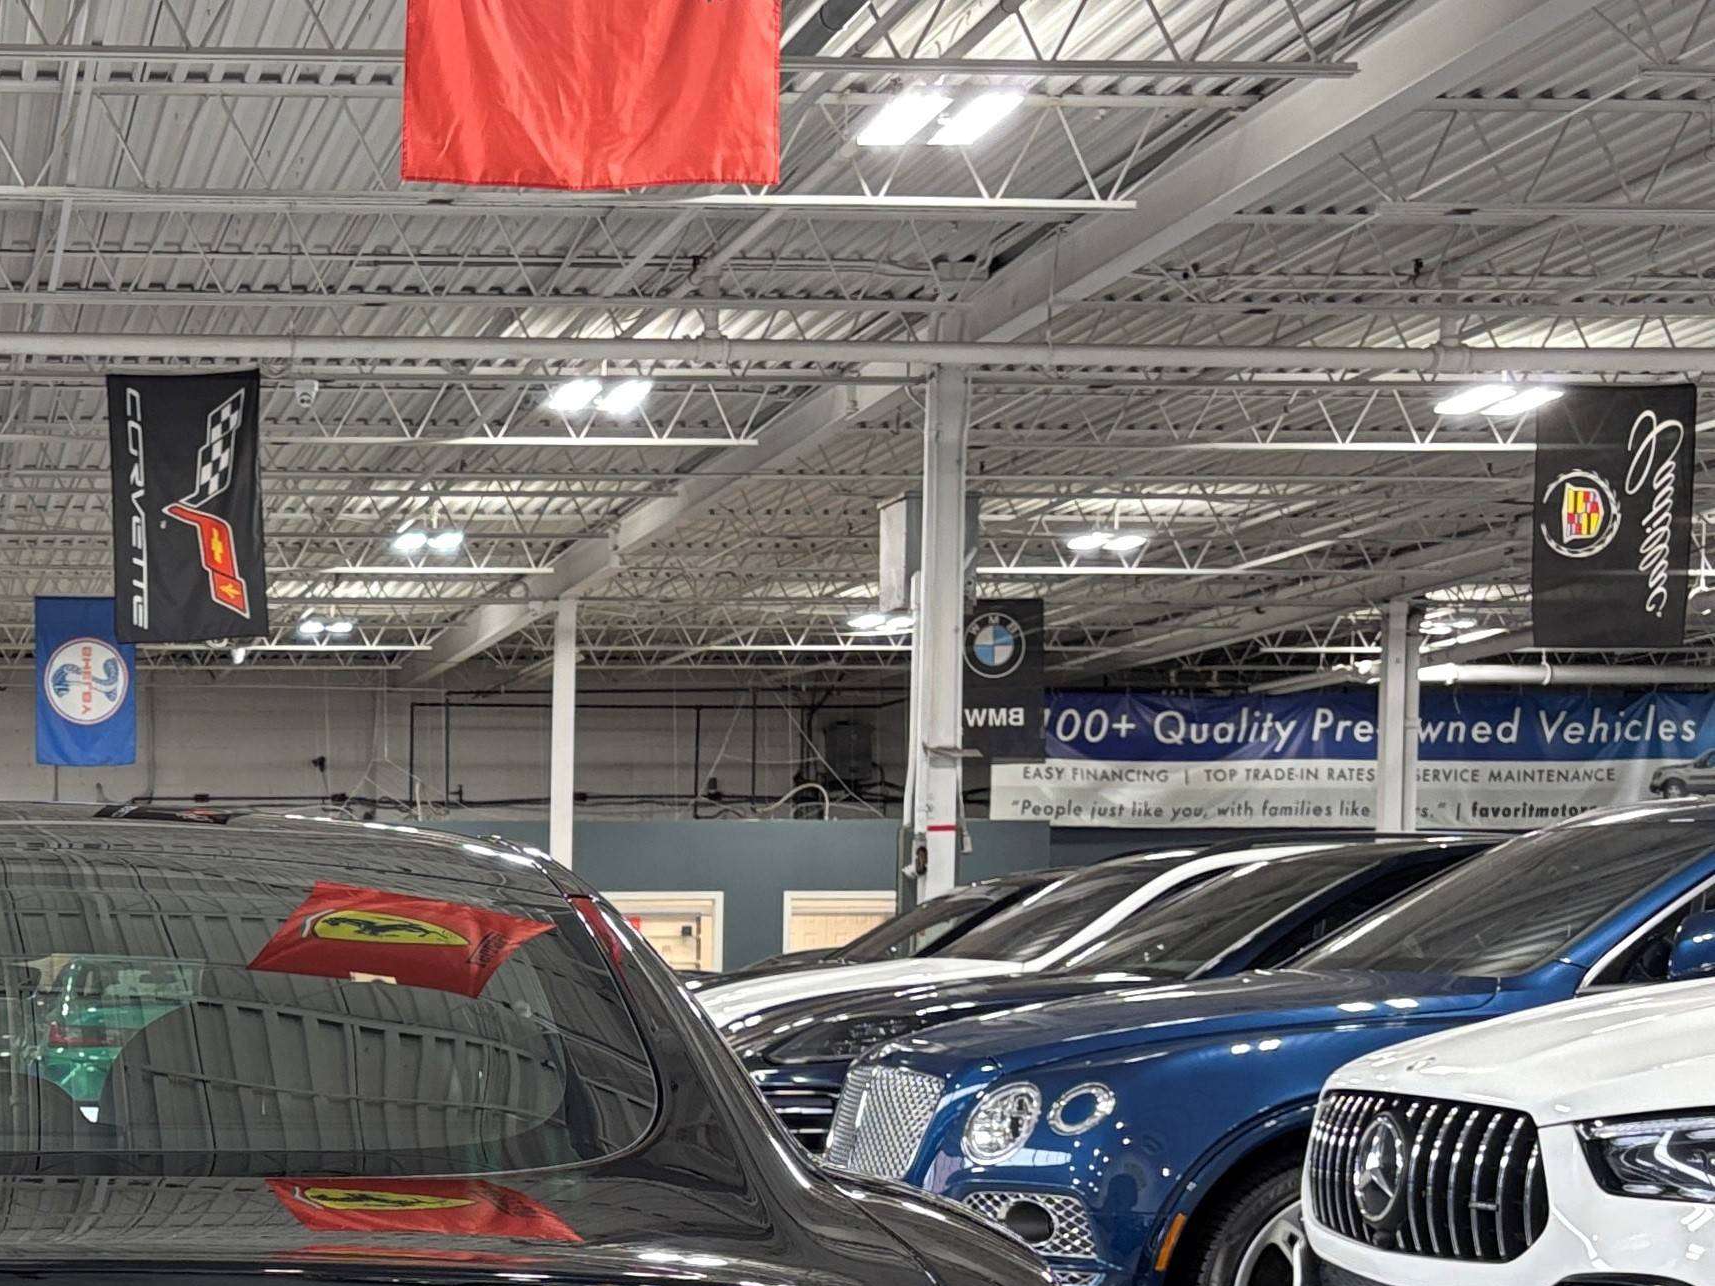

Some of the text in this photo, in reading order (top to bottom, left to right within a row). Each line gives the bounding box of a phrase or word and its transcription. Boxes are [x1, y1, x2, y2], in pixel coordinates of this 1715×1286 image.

[125, 387, 150, 631] CORVETTE
[1153, 706, 1298, 753] Quality
[1538, 704, 1697, 745] Vehicles
[1022, 765, 1065, 781] EASY
[1071, 767, 1170, 784] FINANCING
[1204, 768, 1239, 783] TOP
[1245, 767, 1319, 783] TRADE-IN
[1327, 767, 1376, 783] RATES
[1487, 767, 1616, 783] MAINTENANCE
[1089, 800, 1124, 819] just
[1131, 800, 1164, 818] like
[1217, 800, 1254, 818] with
[1261, 799, 1333, 818] families
[1339, 800, 1372, 817] like
[1471, 801, 1599, 819] favoritmotor
